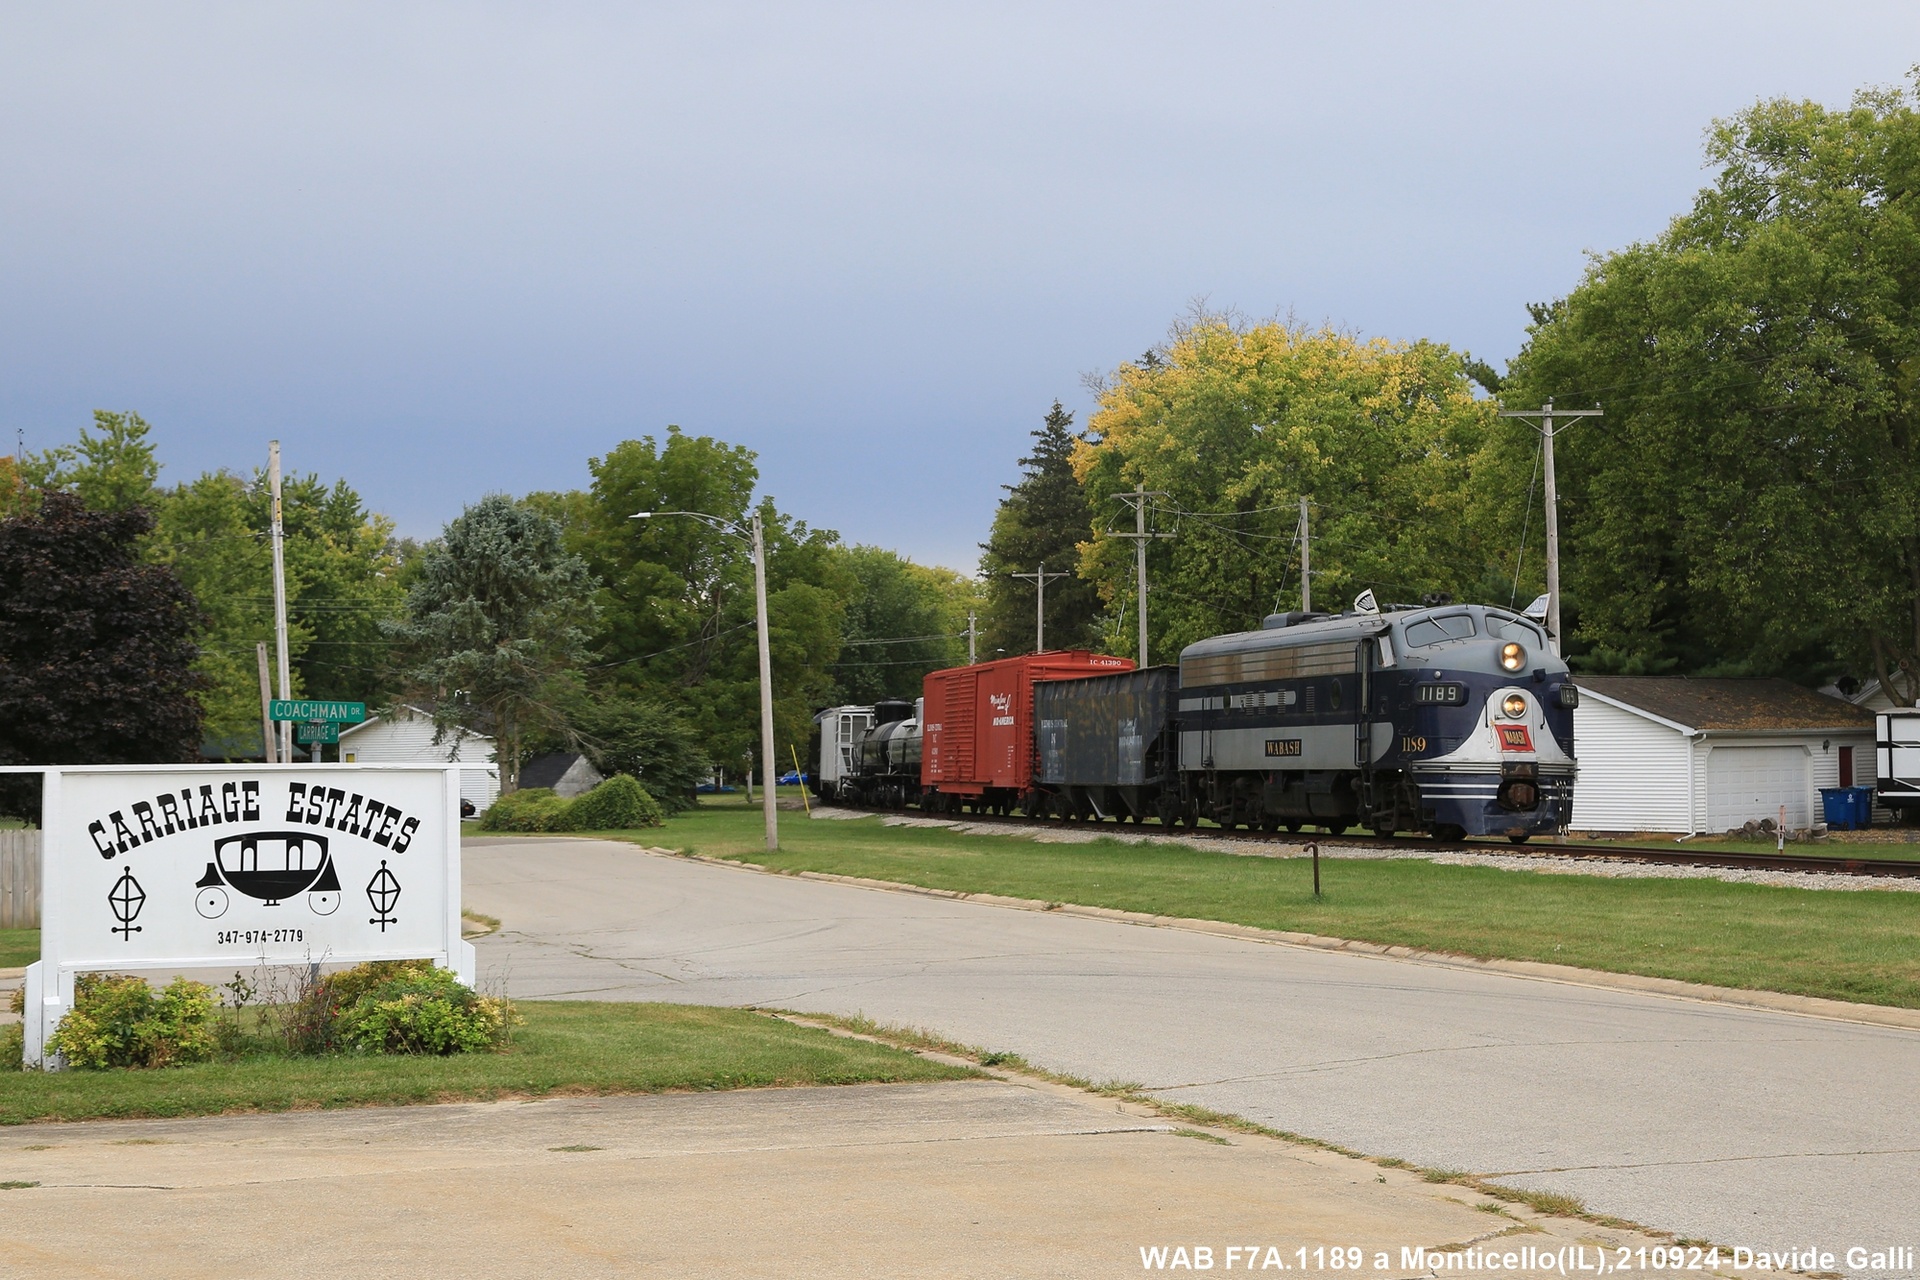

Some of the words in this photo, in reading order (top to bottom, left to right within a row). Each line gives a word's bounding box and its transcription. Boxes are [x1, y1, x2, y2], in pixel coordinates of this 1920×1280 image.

[1422, 686, 1456, 701] 1189
[274, 702, 348, 719] COACHMAN
[299, 725, 329, 740] CARRIAGE
[1267, 741, 1299, 754] WABASH
[1402, 736, 1427, 752] 1189
[88, 780, 260, 860] CARRIAGE
[285, 781, 421, 854] ESTATES
[217, 929, 303, 944] 347-974-2779
